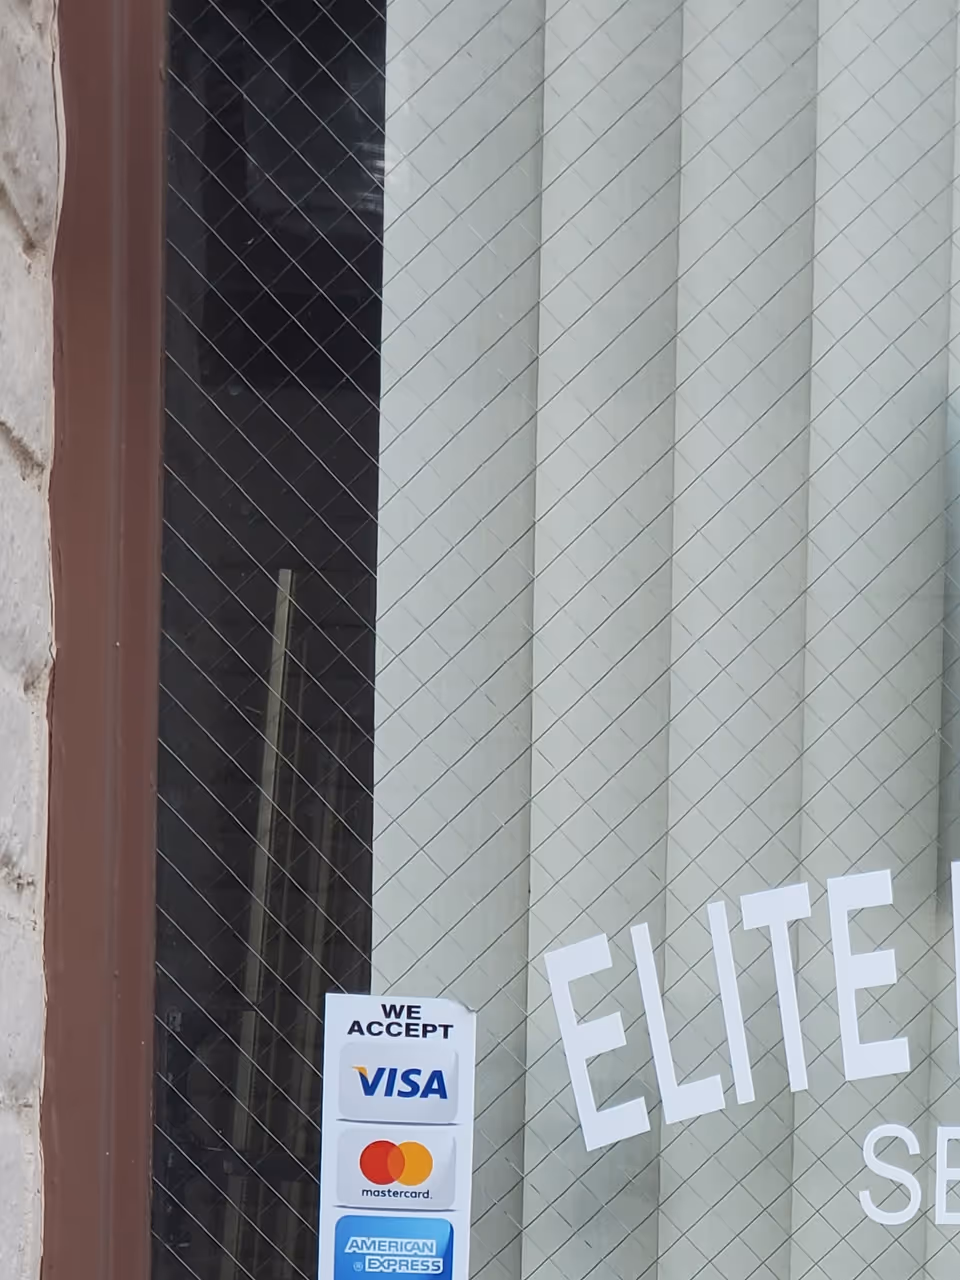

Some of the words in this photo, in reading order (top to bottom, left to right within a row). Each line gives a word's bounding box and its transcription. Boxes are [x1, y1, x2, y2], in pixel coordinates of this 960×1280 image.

[381, 1003, 422, 1020] WE
[543, 868, 911, 1152] ELITE
[347, 1020, 454, 1039] ACCEPT
[351, 1066, 448, 1100] VISA
[344, 1236, 437, 1256] AMERICAN
[365, 1255, 444, 1275] EXPRESS
